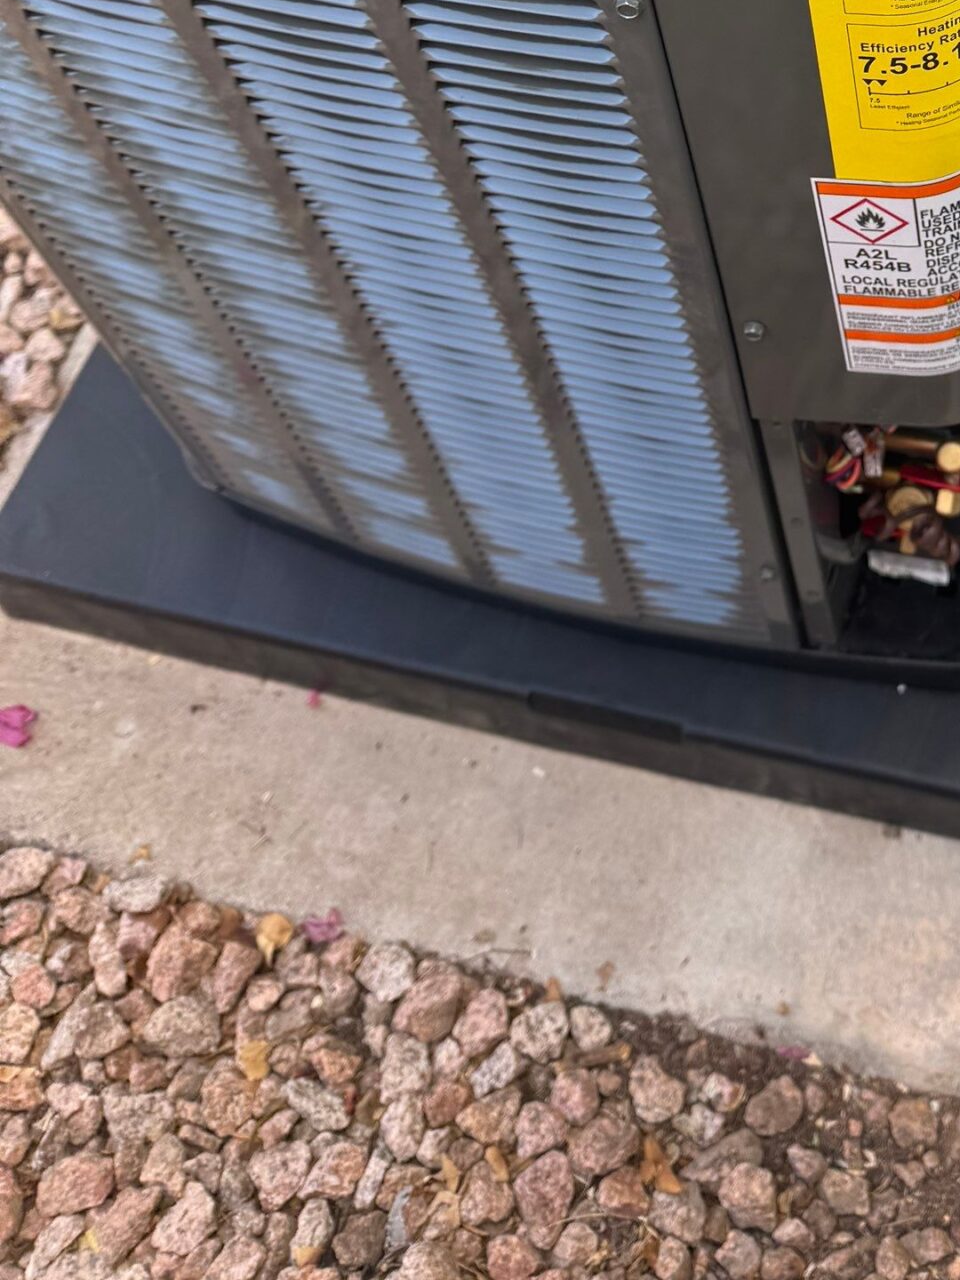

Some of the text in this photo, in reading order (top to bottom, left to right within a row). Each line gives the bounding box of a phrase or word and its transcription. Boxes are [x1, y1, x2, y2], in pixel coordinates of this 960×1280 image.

[860, 42, 934, 54] Efficiency
[906, 110, 931, 119] Range
[933, 107, 941, 115] of
[924, 237, 946, 249] DO
[856, 248, 898, 260] A2L
[844, 258, 912, 272] R454B
[842, 275, 894, 287] LOCAL
[844, 285, 937, 298] FLAMMABLE
